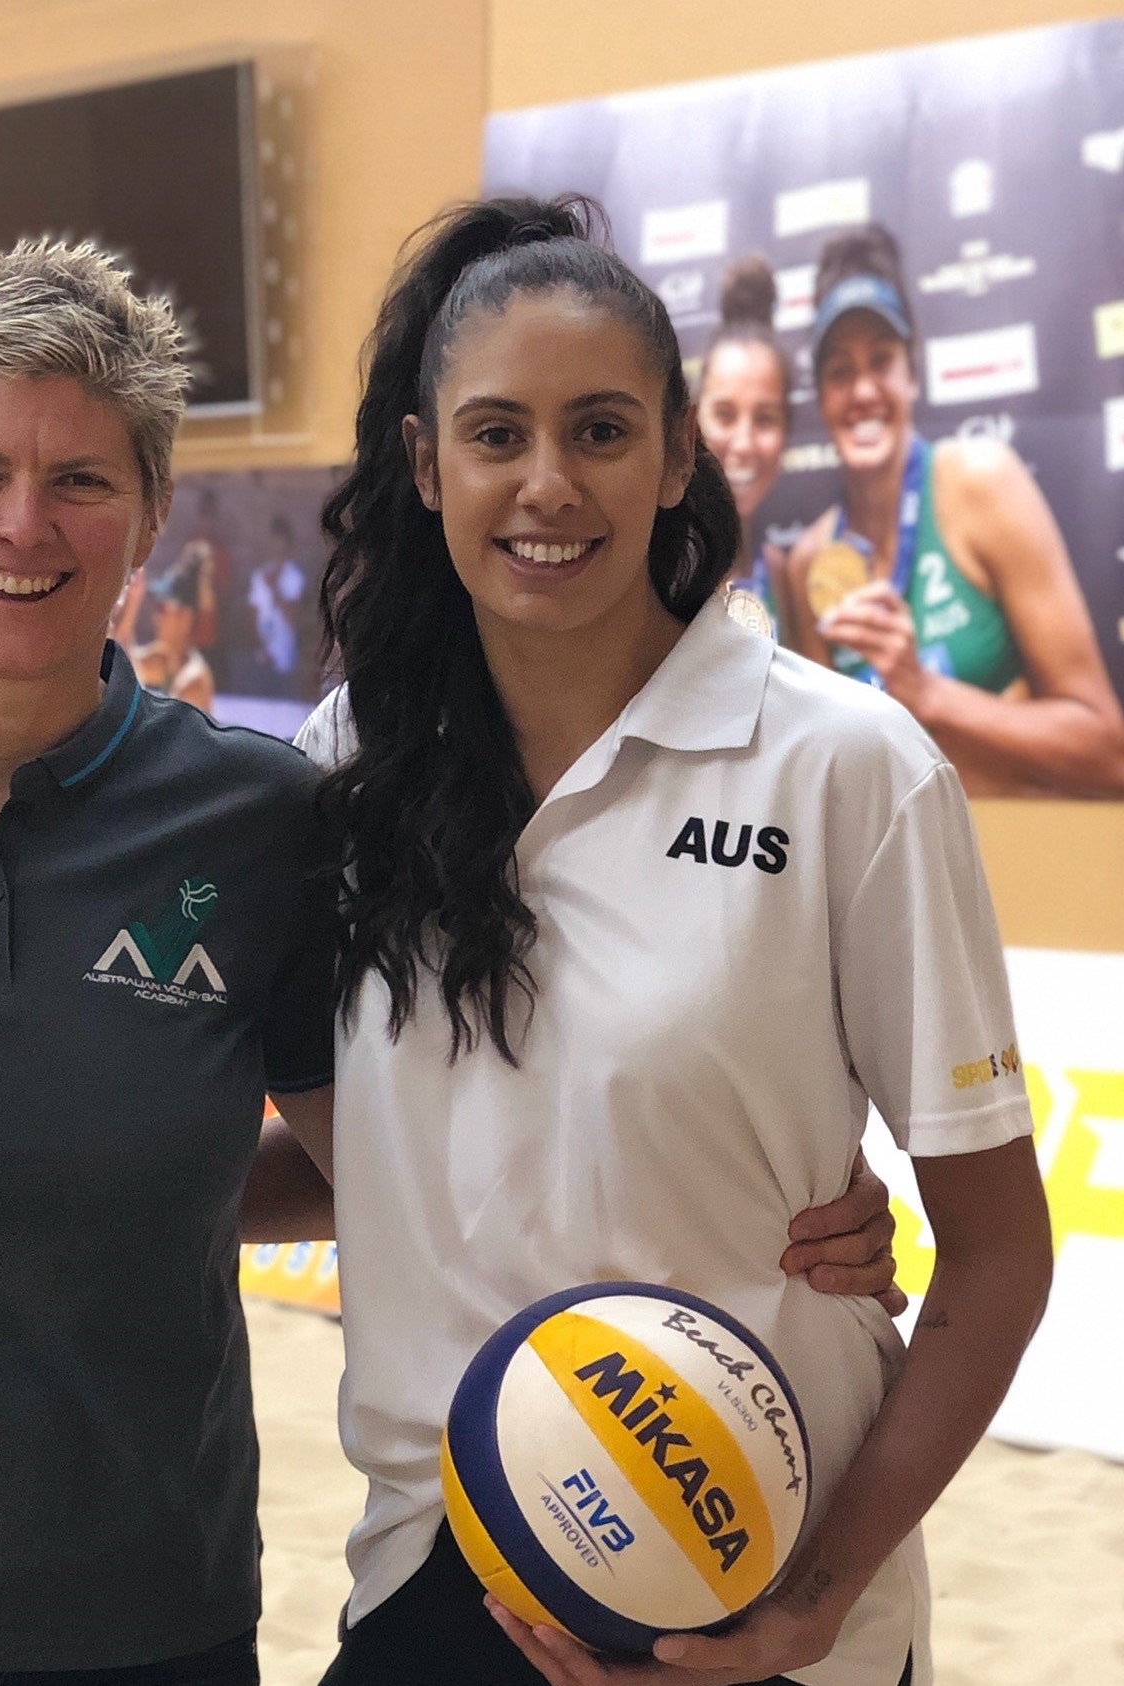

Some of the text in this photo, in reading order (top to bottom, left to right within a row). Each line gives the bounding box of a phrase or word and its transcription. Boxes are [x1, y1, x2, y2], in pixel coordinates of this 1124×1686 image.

[917, 551, 954, 607] 2
[666, 816, 790, 875] AUS
[82, 971, 161, 992] AUSTRALIAN
[661, 1309, 754, 1382] Beach
[540, 1494, 600, 1569] APPROVED
[562, 1468, 636, 1553] FIVB
